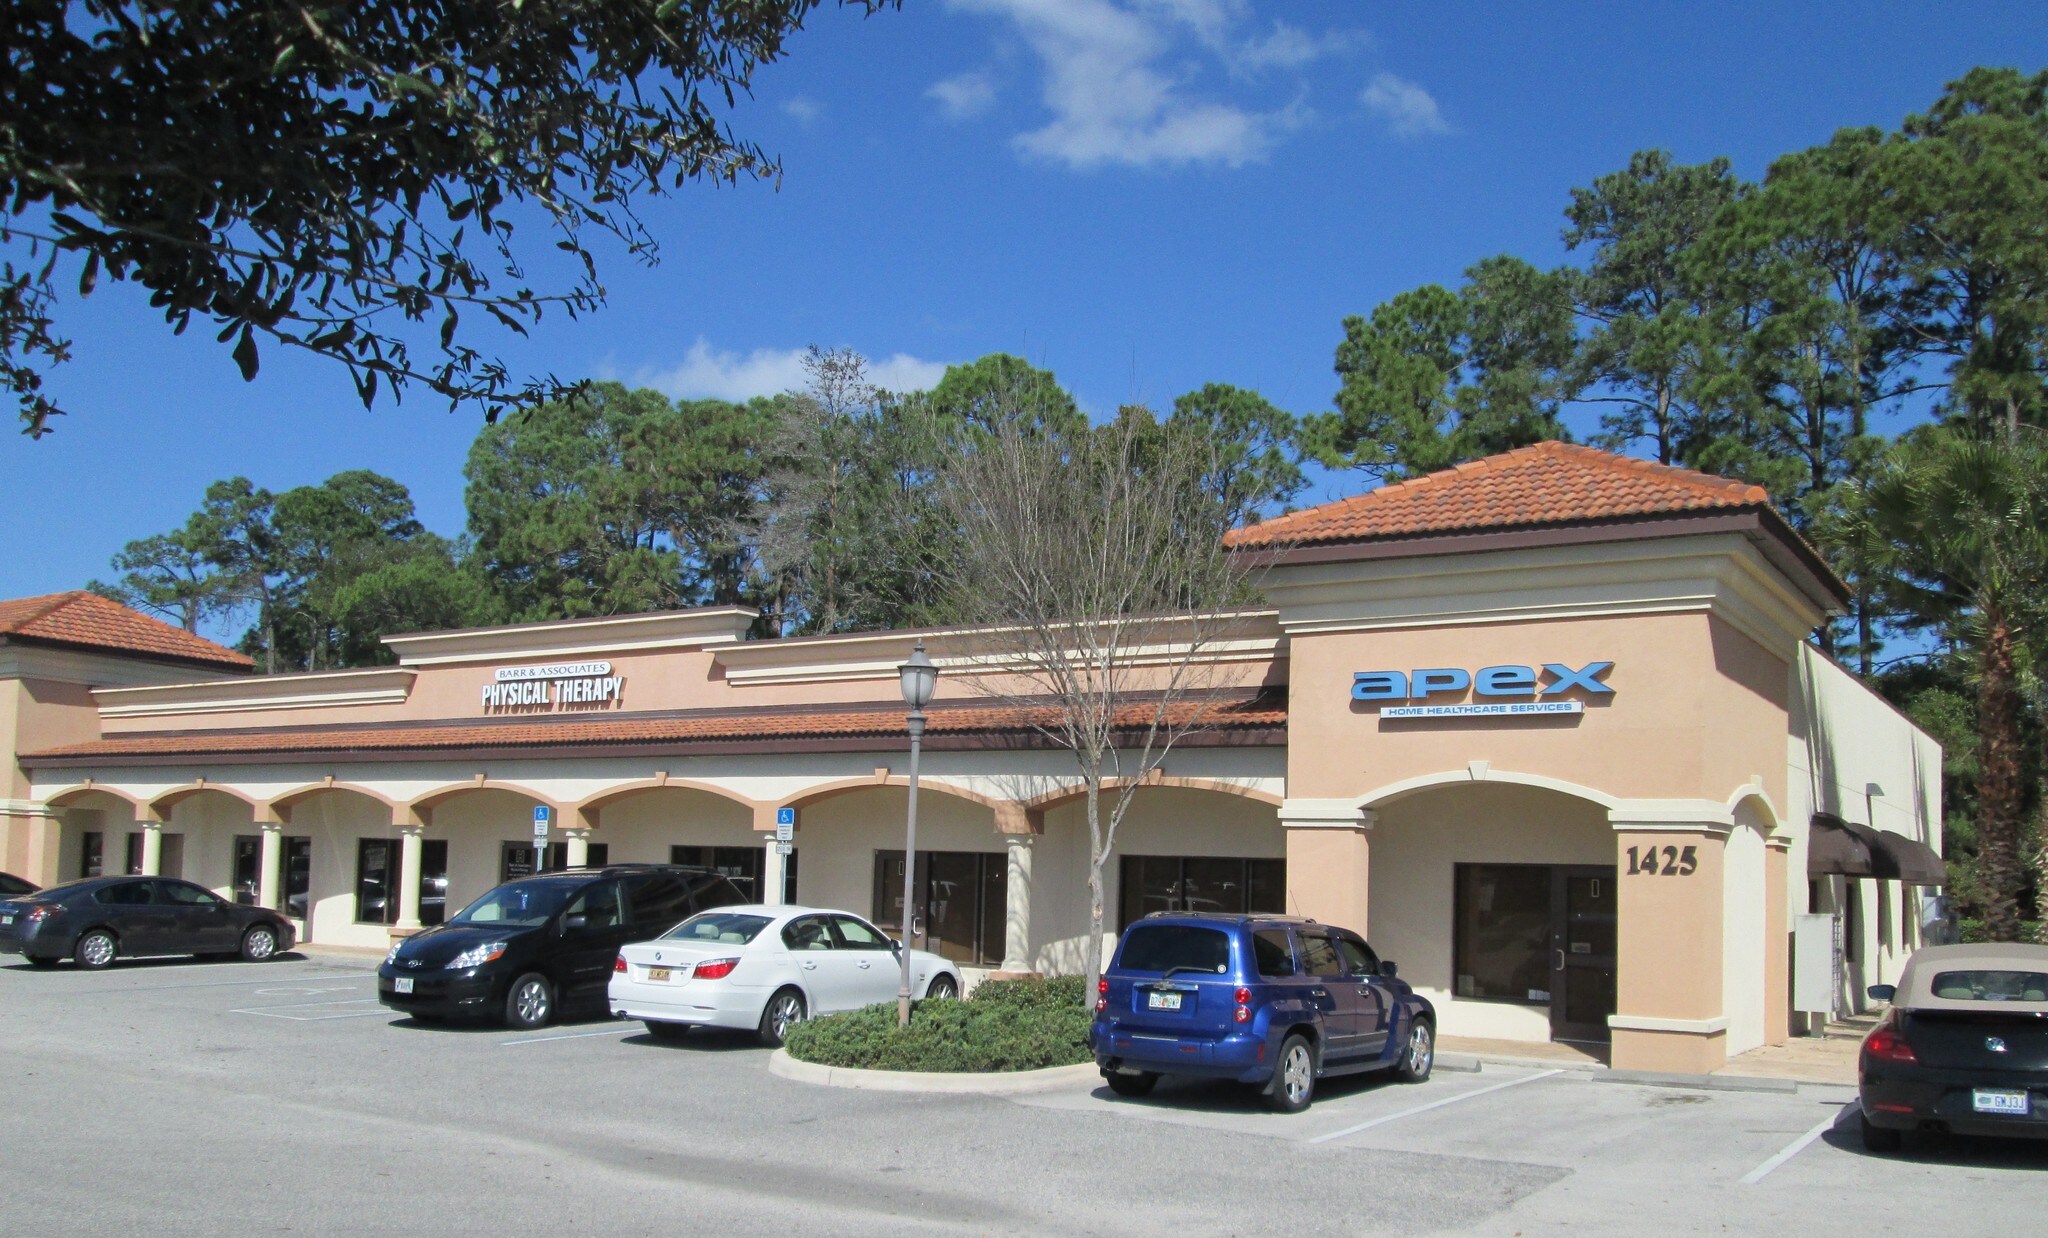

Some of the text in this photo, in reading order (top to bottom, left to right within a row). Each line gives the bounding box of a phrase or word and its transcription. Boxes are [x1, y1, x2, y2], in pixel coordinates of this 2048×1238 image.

[499, 663, 606, 679] BARR & ASSOCIATES
[1351, 661, 1617, 700] apex
[481, 676, 624, 707] PHYSICAL THERAPY
[1388, 703, 1573, 717] HOME HEALTHCARE SERVICES
[1626, 845, 1698, 876] 1425
